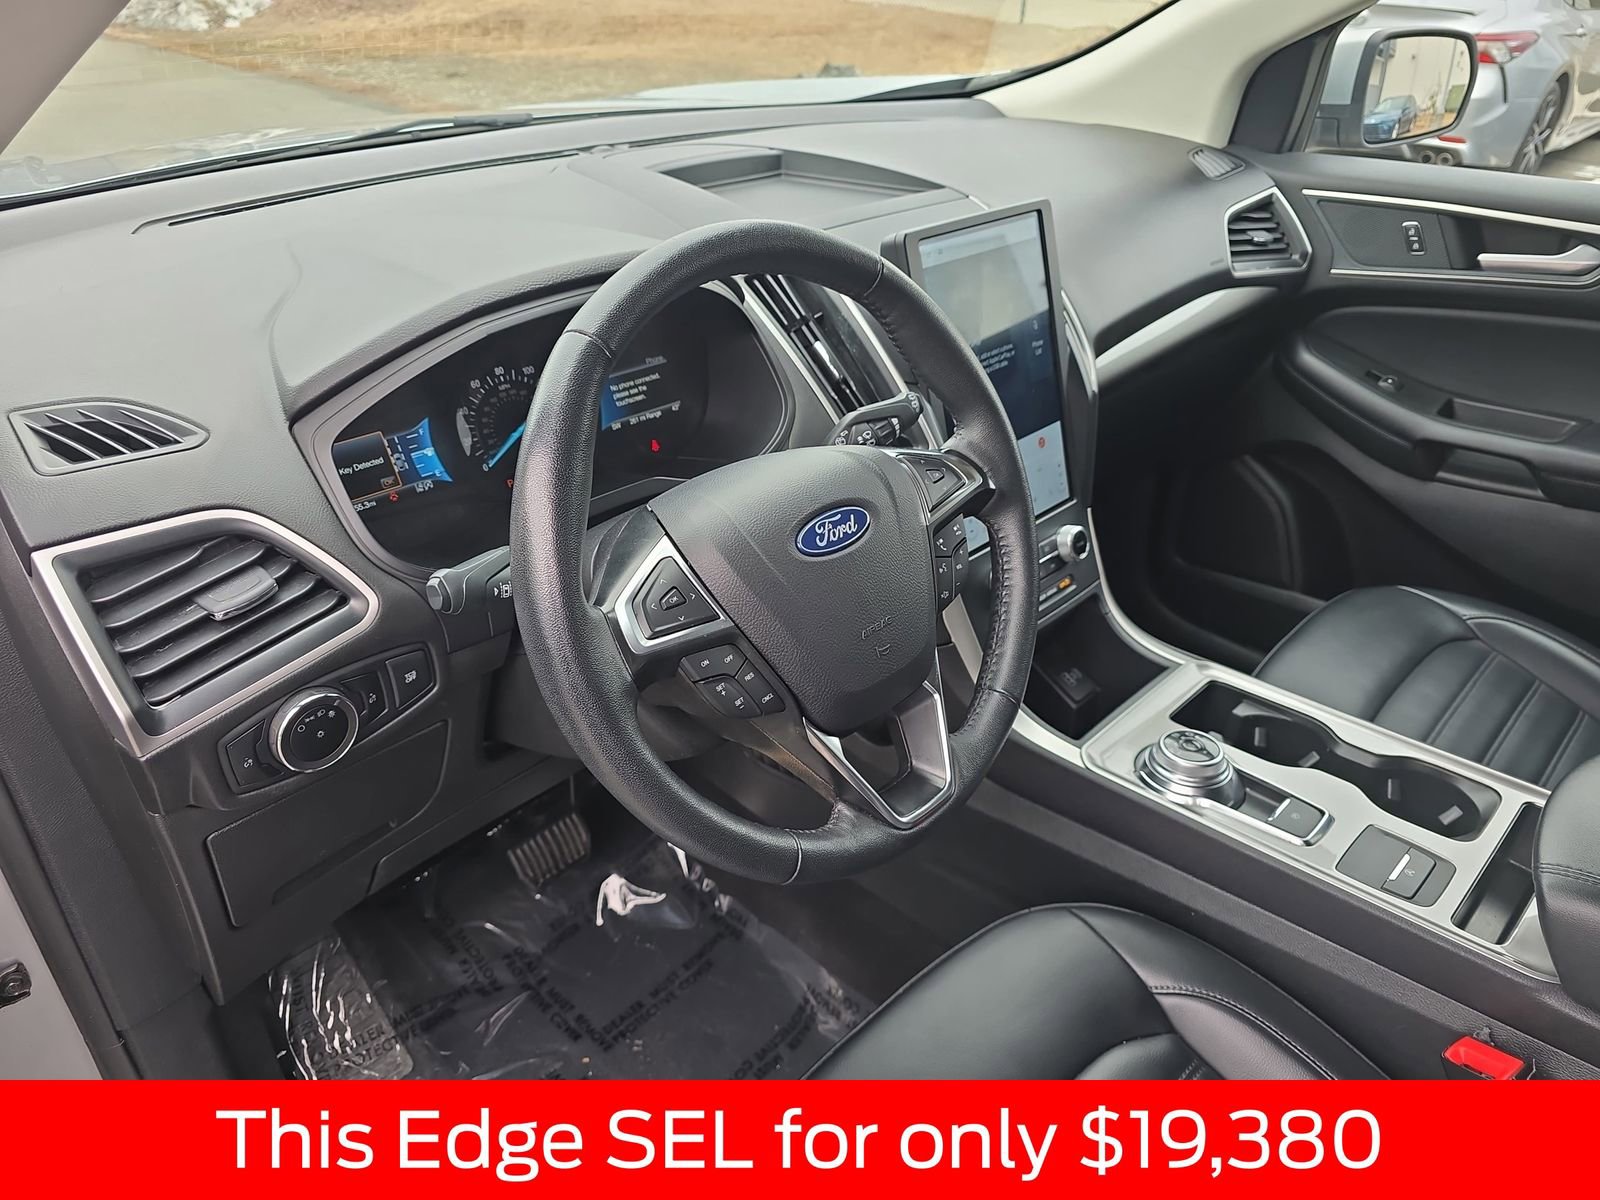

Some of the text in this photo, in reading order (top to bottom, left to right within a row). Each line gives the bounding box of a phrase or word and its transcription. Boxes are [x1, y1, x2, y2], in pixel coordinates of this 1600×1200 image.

[338, 457, 384, 476] Key Detected
[815, 513, 858, 547] Ford
[700, 659, 710, 667] ON
[724, 654, 734, 664] OFF
[744, 672, 755, 681] RES
[716, 682, 726, 692] SET
[735, 696, 745, 707] SET
